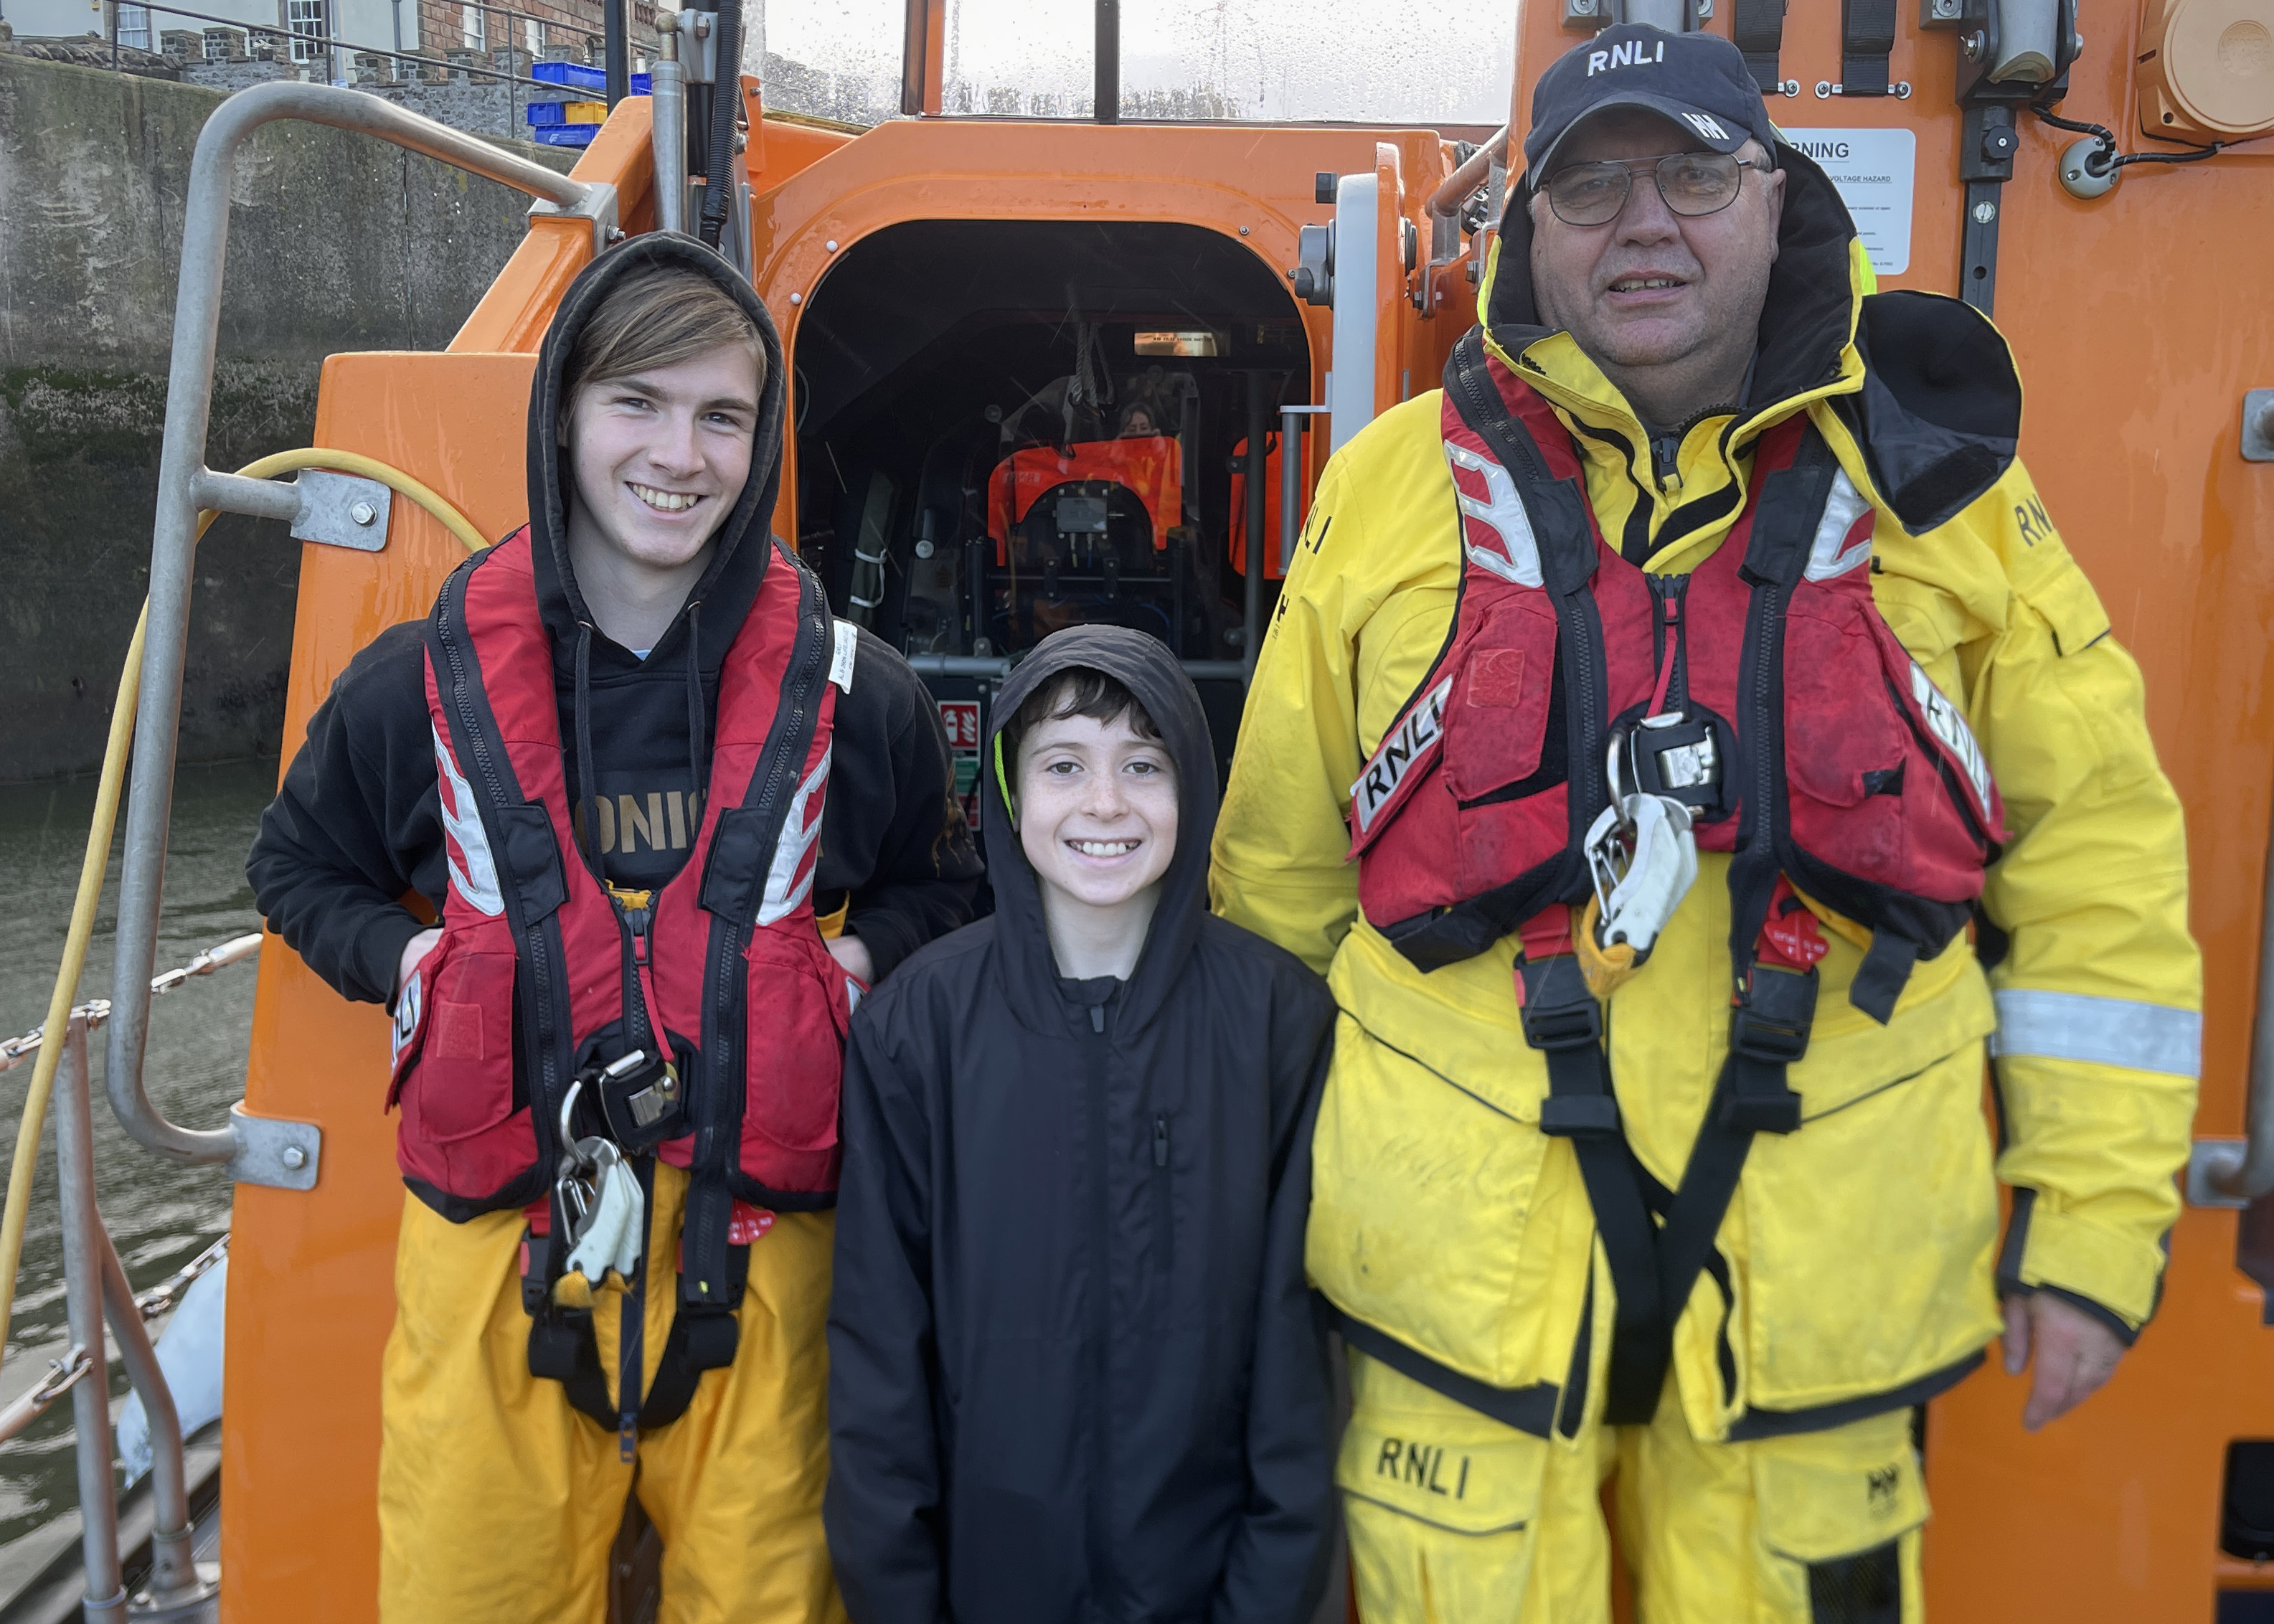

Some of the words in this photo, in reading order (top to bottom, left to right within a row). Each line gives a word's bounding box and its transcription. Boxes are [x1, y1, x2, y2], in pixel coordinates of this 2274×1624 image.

[1587, 41, 1664, 77] RNLI
[2014, 494, 2054, 547] RN
[1366, 693, 1442, 811] RNLI
[1377, 1437, 1470, 1500] RNLI
